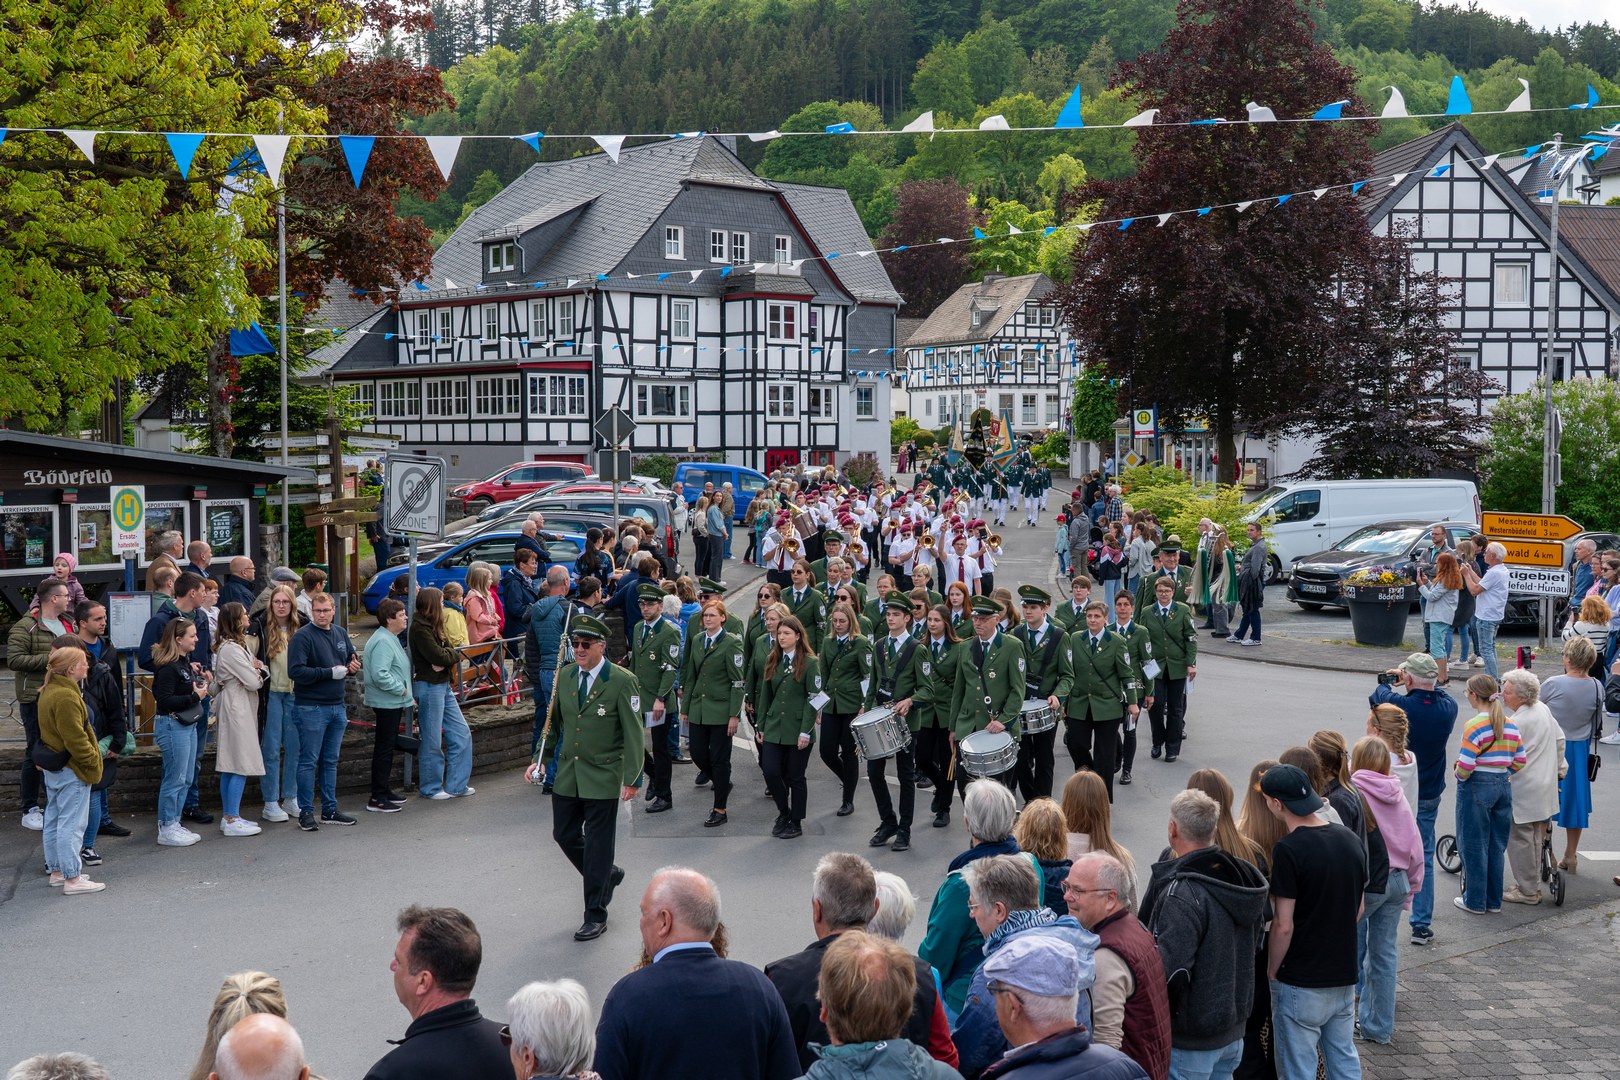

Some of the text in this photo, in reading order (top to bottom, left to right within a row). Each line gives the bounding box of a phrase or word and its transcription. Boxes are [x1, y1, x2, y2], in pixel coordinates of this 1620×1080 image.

[802, 454, 808, 463] 3
[23, 469, 113, 486] Bödefeld
[402, 516, 427, 529] ZONE
[1498, 518, 1537, 526] Meschede
[1489, 526, 1537, 536] Westernbödefeld
[1507, 550, 1529, 558] wald
